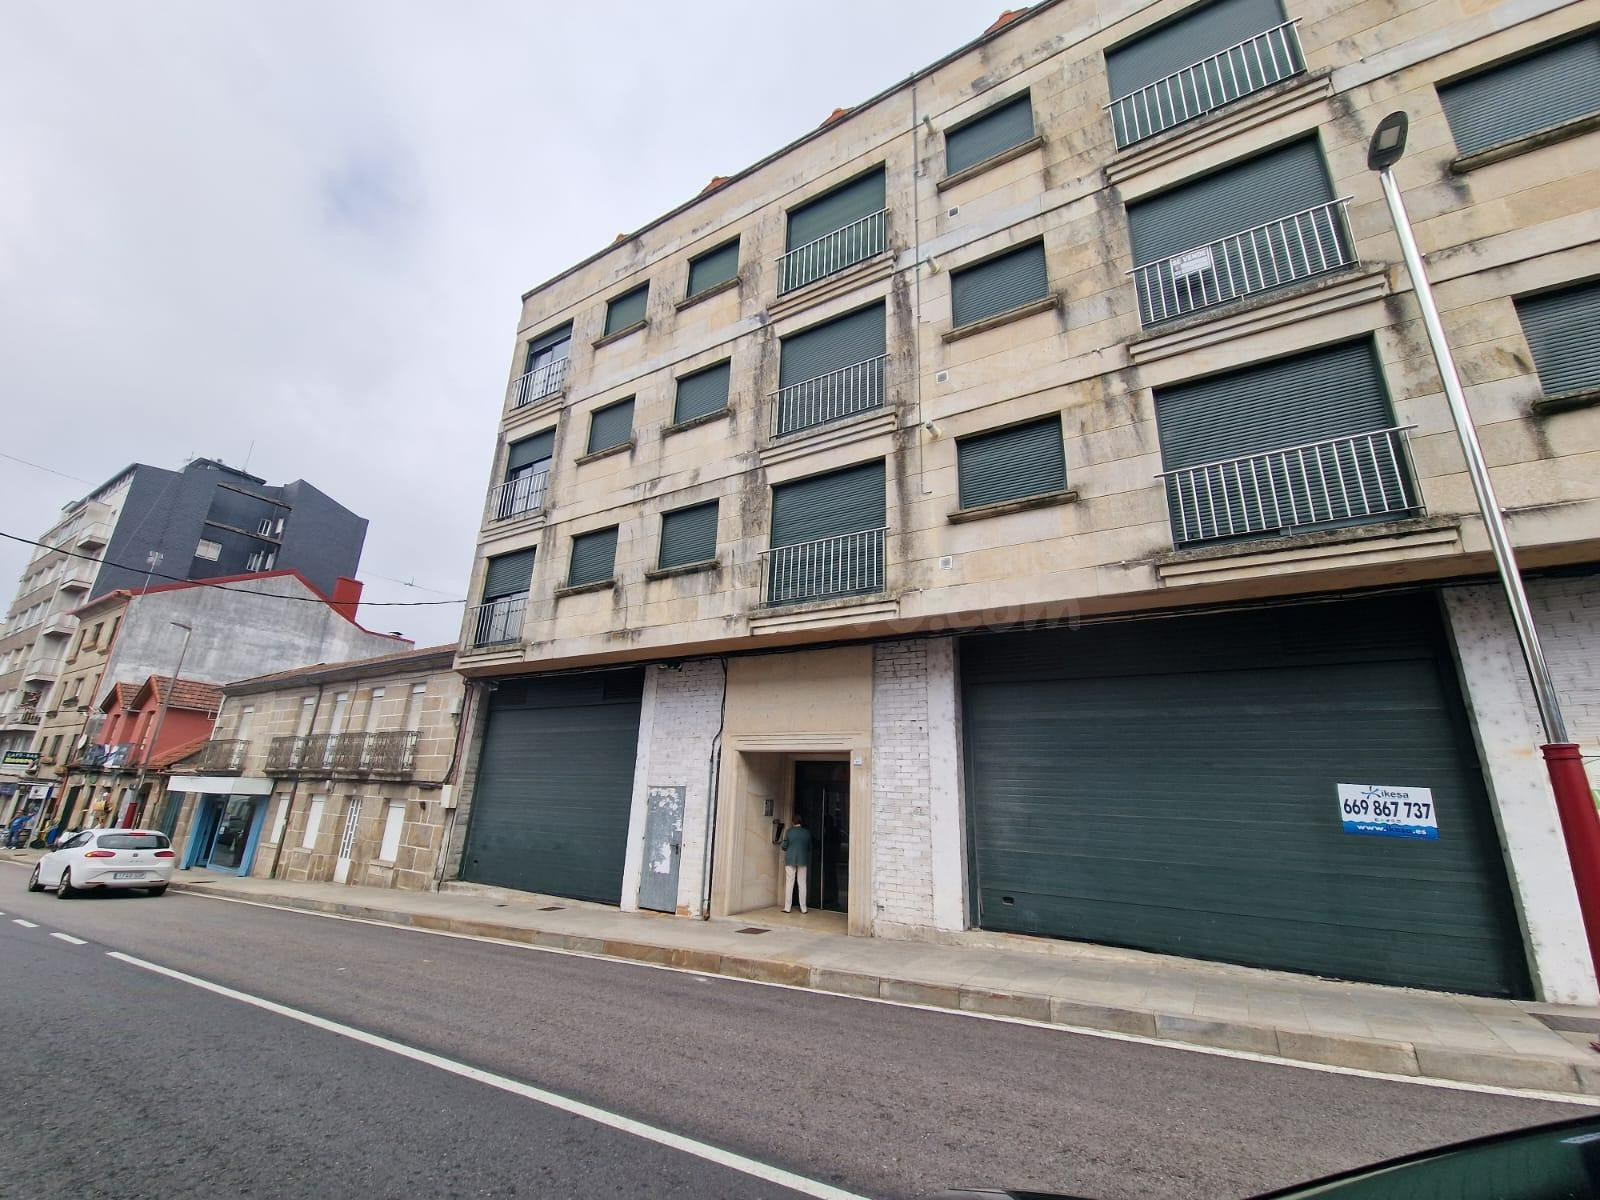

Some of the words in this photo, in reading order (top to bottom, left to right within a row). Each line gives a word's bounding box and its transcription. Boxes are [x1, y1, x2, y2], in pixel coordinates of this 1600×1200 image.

[1343, 798, 1369, 815] 669
[1373, 800, 1399, 817] 867
[1403, 802, 1430, 819] 737
